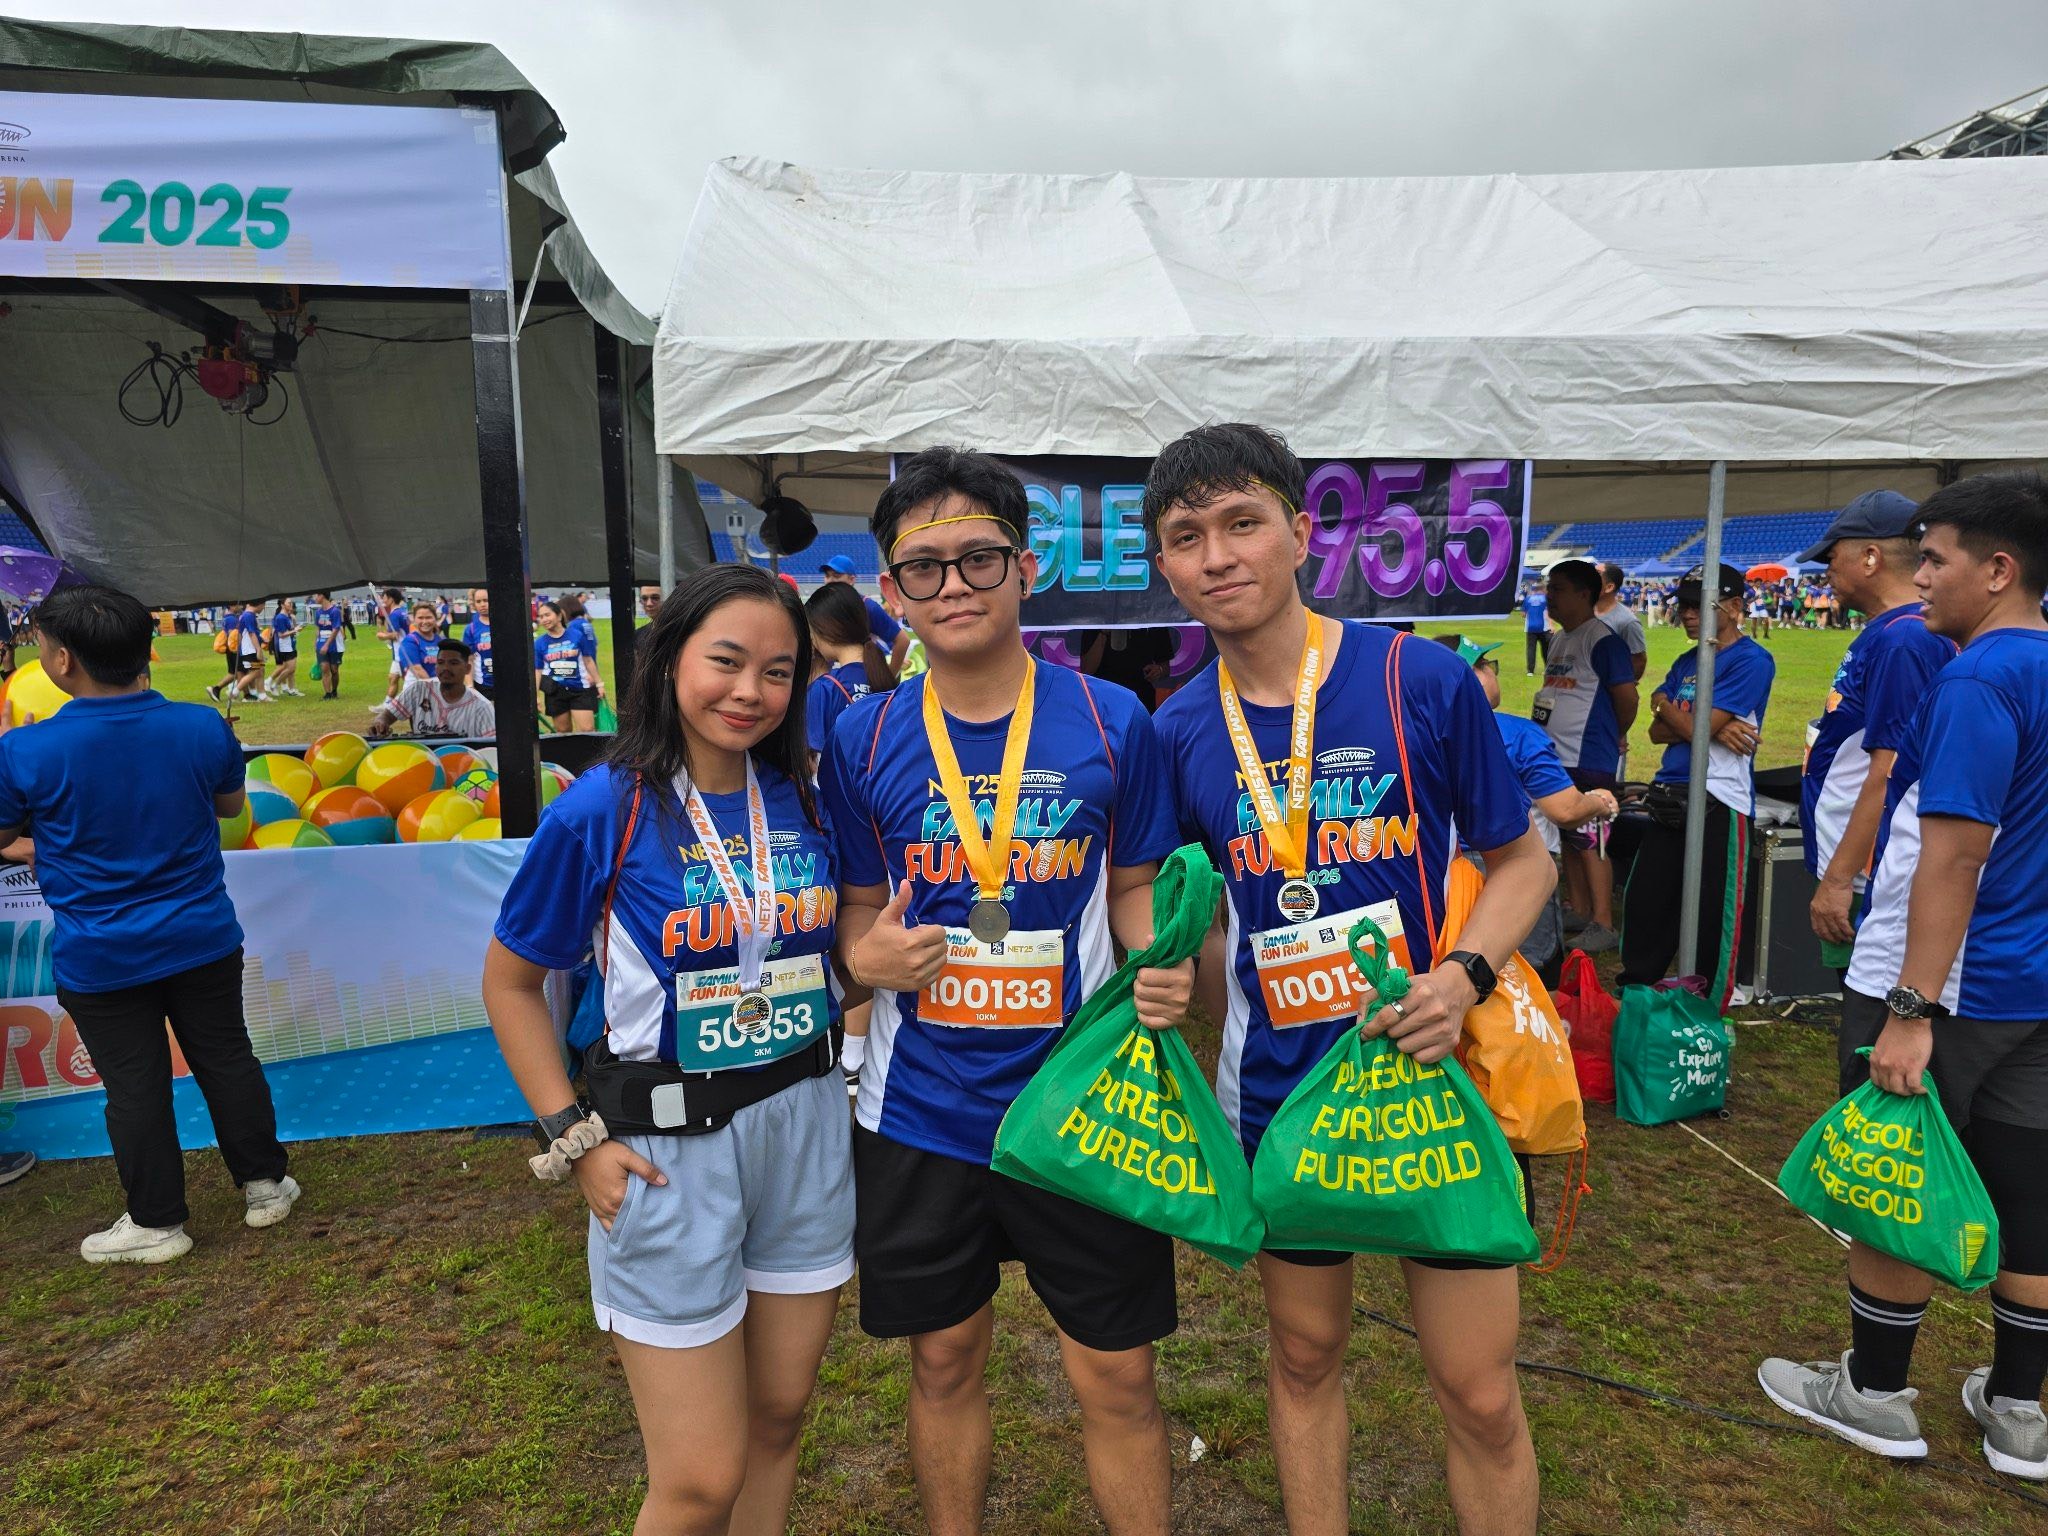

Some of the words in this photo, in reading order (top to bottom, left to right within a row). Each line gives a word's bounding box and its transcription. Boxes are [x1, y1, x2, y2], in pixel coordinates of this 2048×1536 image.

[98, 179, 293, 249] 2025
[1304, 460, 1513, 598] 95.5
[1304, 648, 1319, 677] RUN
[1299, 679, 1313, 706] FUN
[1295, 705, 1309, 758] FAMILY
[1224, 690, 1243, 731] 10KM
[1236, 735, 1278, 824] FINISHER
[928, 775, 1000, 797] NT25
[1291, 766, 1306, 809] NET25
[753, 813, 765, 836] FUN
[678, 836, 748, 863] NE25
[753, 837, 770, 883] FAMILY
[1006, 835, 1093, 882] RUN
[1228, 832, 1284, 881] FU
[1317, 813, 1419, 866] RUN
[706, 841, 752, 936] FINISHER
[1306, 868, 1341, 885] 025
[758, 890, 771, 933] NET25
[772, 885, 837, 937] RUN
[946, 933, 972, 945] MILY
[950, 945, 978, 958] RUN
[1261, 948, 1281, 961] FUN
[1283, 941, 1309, 957] RUN
[1264, 931, 1299, 948] FAMILY
[695, 972, 740, 987] FAMILY
[774, 972, 796, 981] NET25
[689, 986, 717, 1001] FUN
[930, 976, 1052, 1010] 100133
[1328, 1001, 1351, 1012] 10KM
[976, 1013, 997, 1021] 10KM
[754, 1047, 772, 1057] 5KM
[1696, 1037, 1713, 1052] Go
[1293, 1141, 1482, 1194] PUREGOLD
